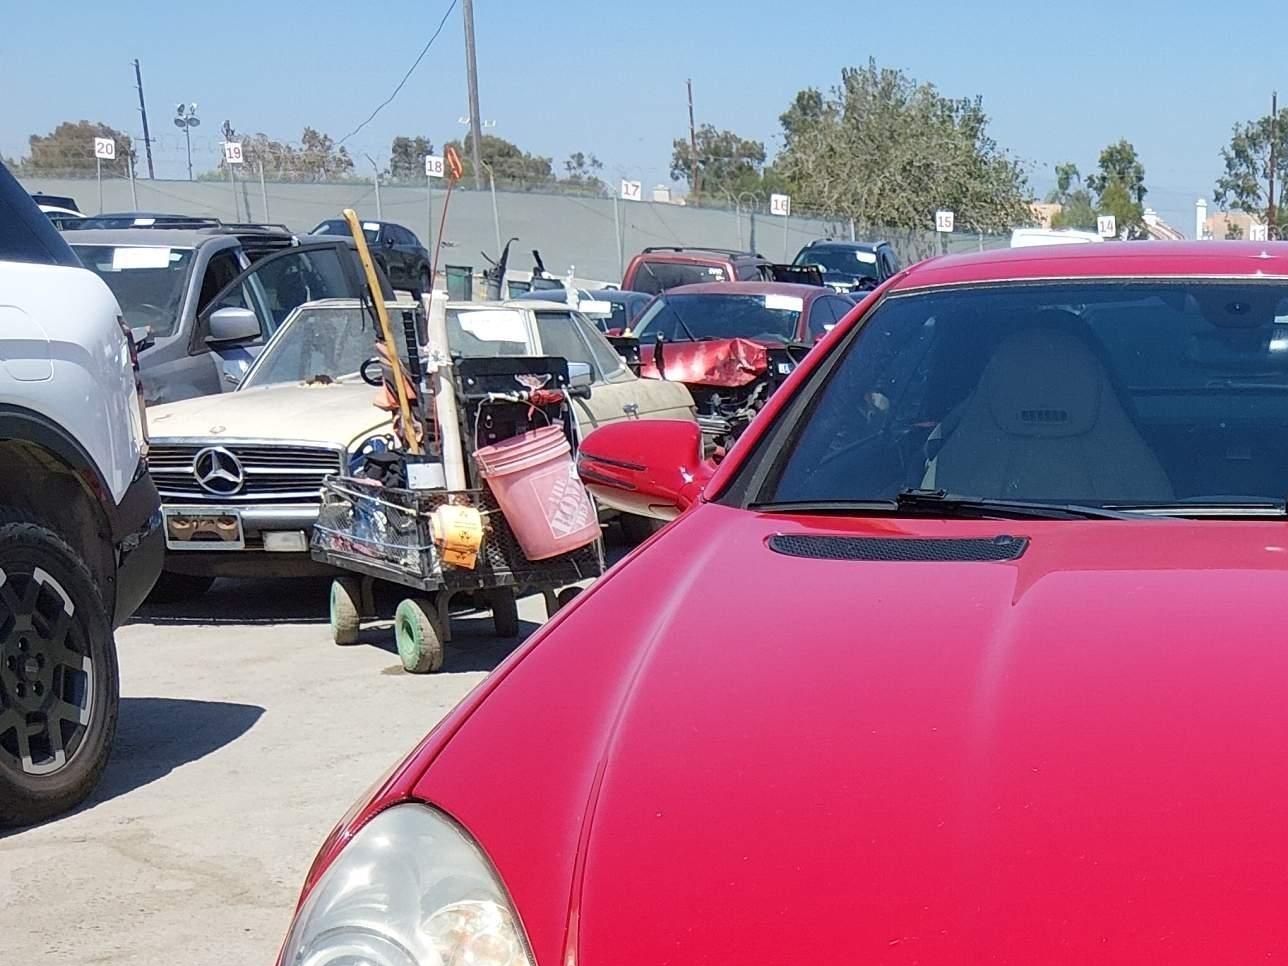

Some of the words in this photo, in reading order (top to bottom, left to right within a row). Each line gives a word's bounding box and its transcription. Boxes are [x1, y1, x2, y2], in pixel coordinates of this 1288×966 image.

[96, 142, 114, 155] 20
[226, 146, 242, 159] 19
[427, 160, 443, 173] 18
[623, 183, 640, 196] 17
[773, 198, 788, 211] 16
[938, 215, 953, 228] 15
[1099, 220, 1114, 233] 14
[1251, 228, 1266, 241] 13
